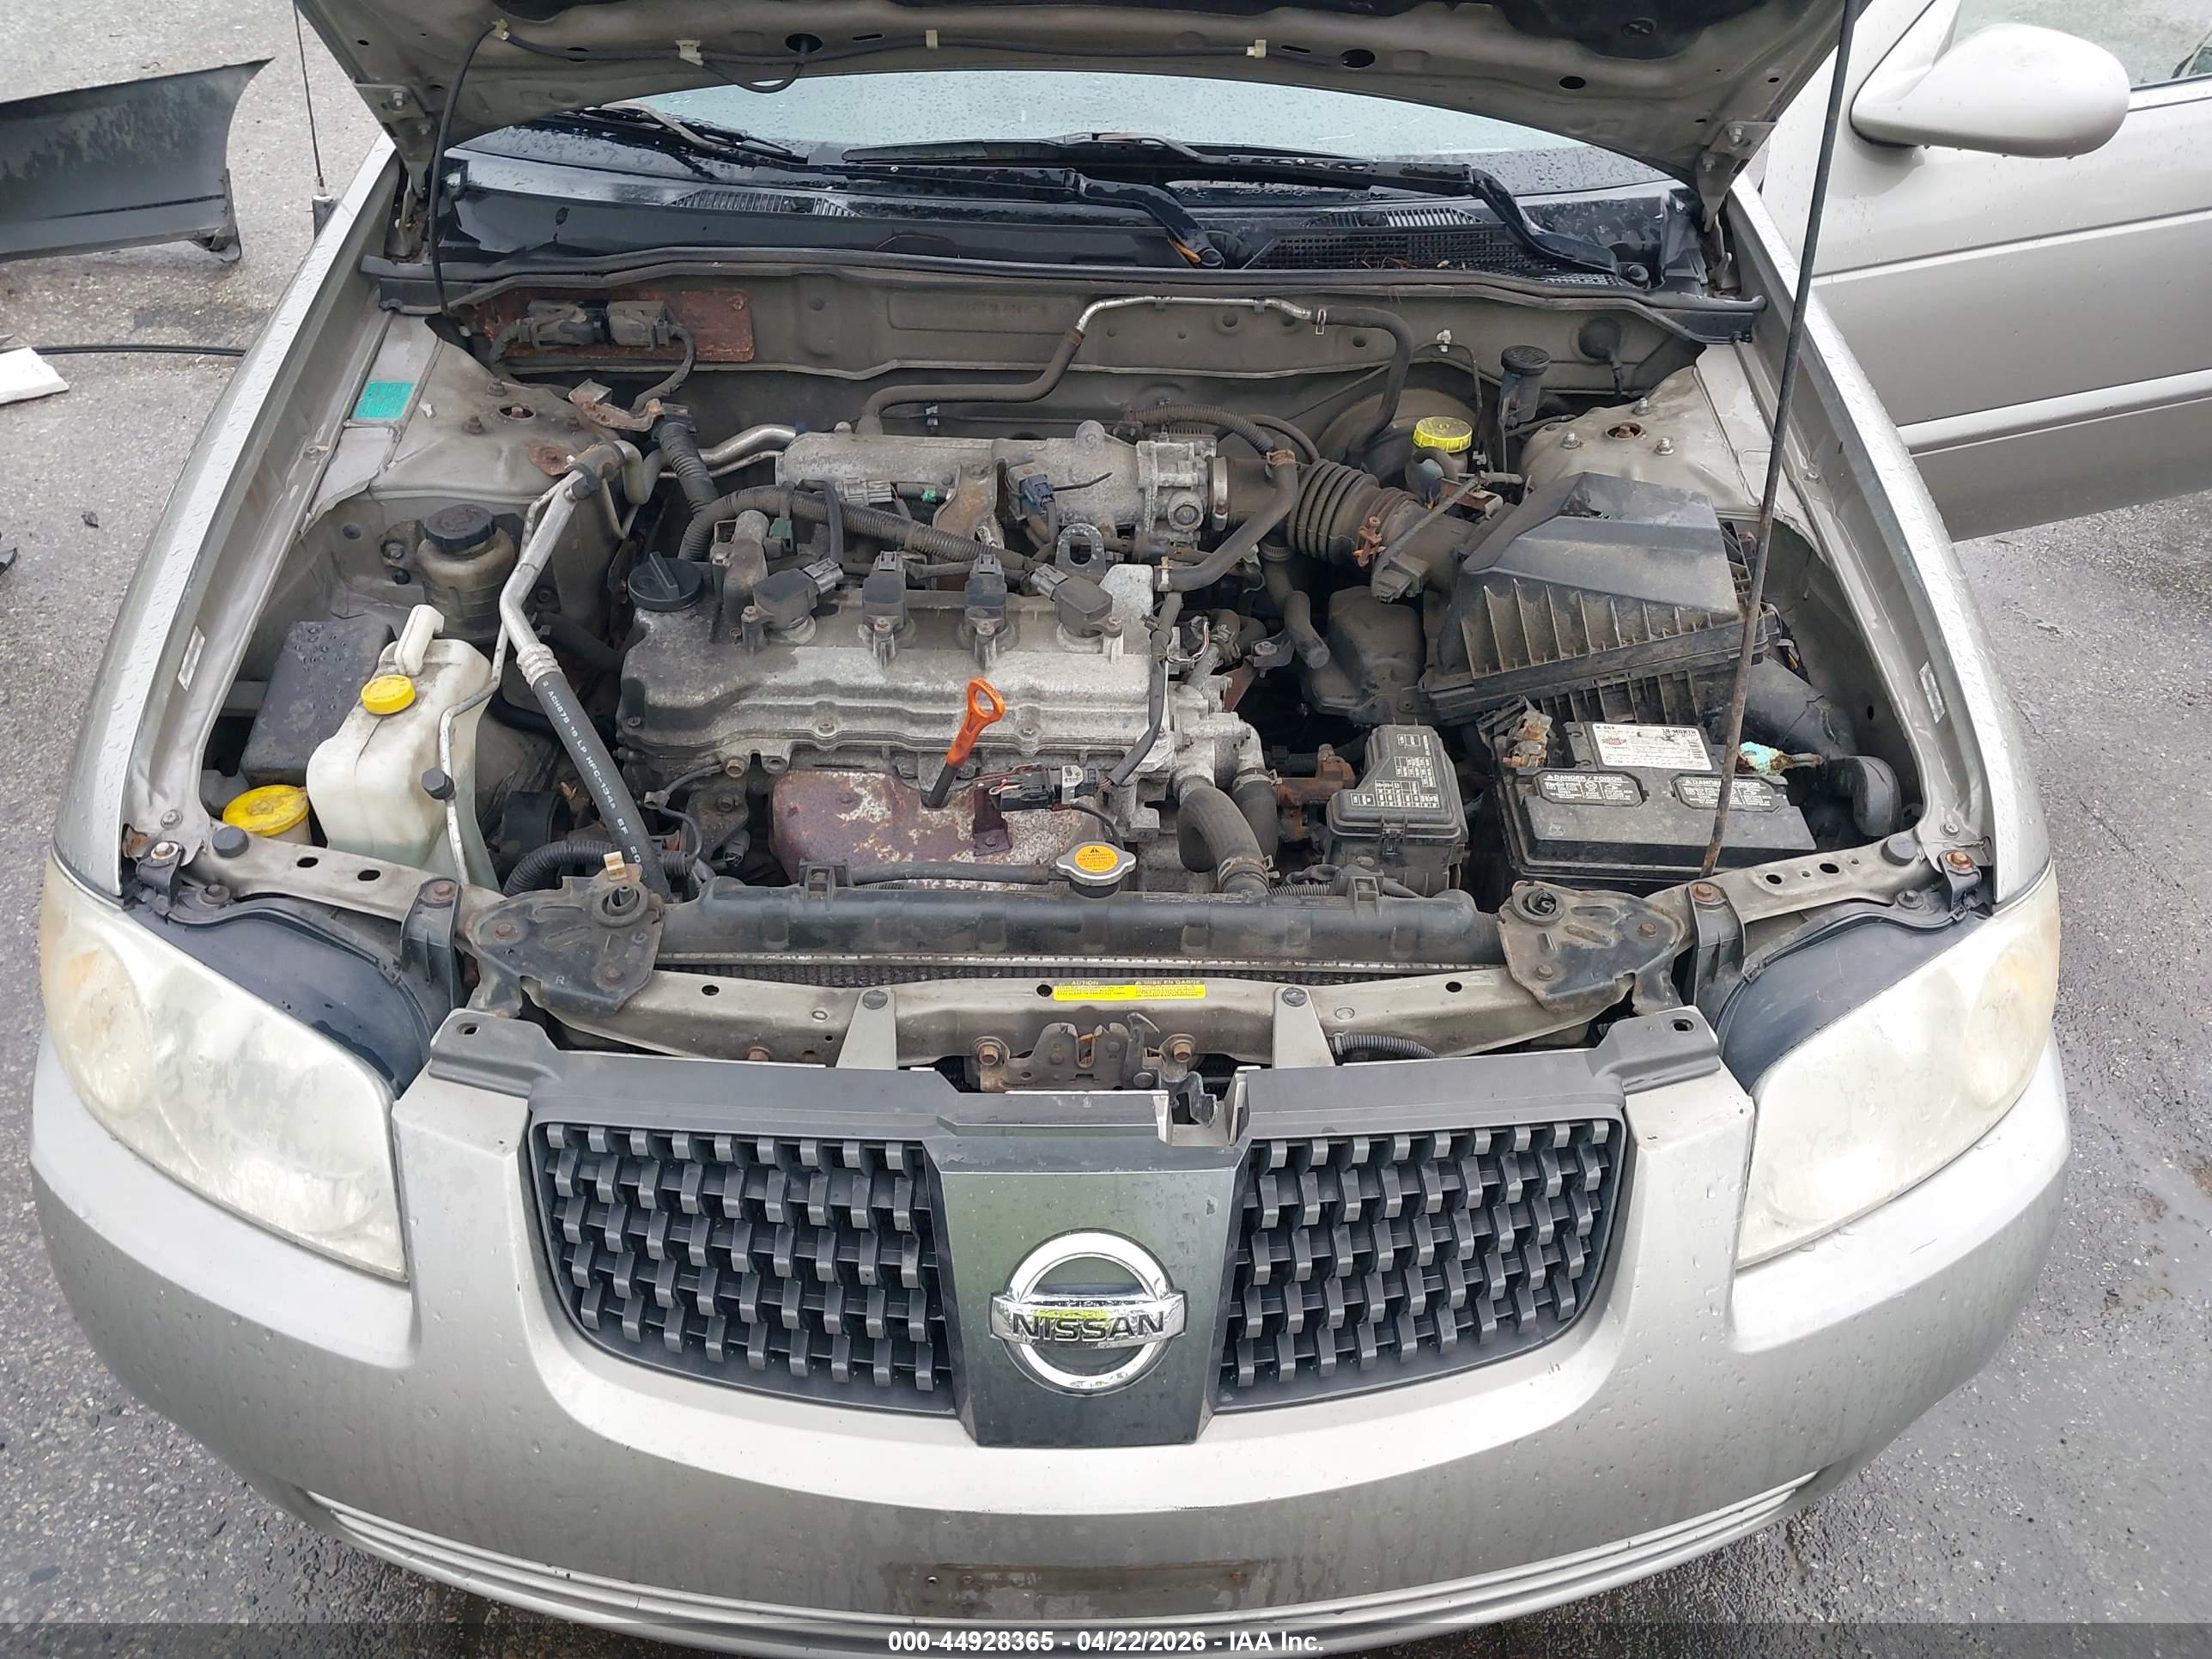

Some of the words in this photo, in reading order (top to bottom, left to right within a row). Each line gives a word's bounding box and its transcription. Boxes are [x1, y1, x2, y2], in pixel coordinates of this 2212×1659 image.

[576, 739, 587, 753] LP
[556, 975, 565, 985] R
[1012, 1311, 1164, 1342] NISSAN
